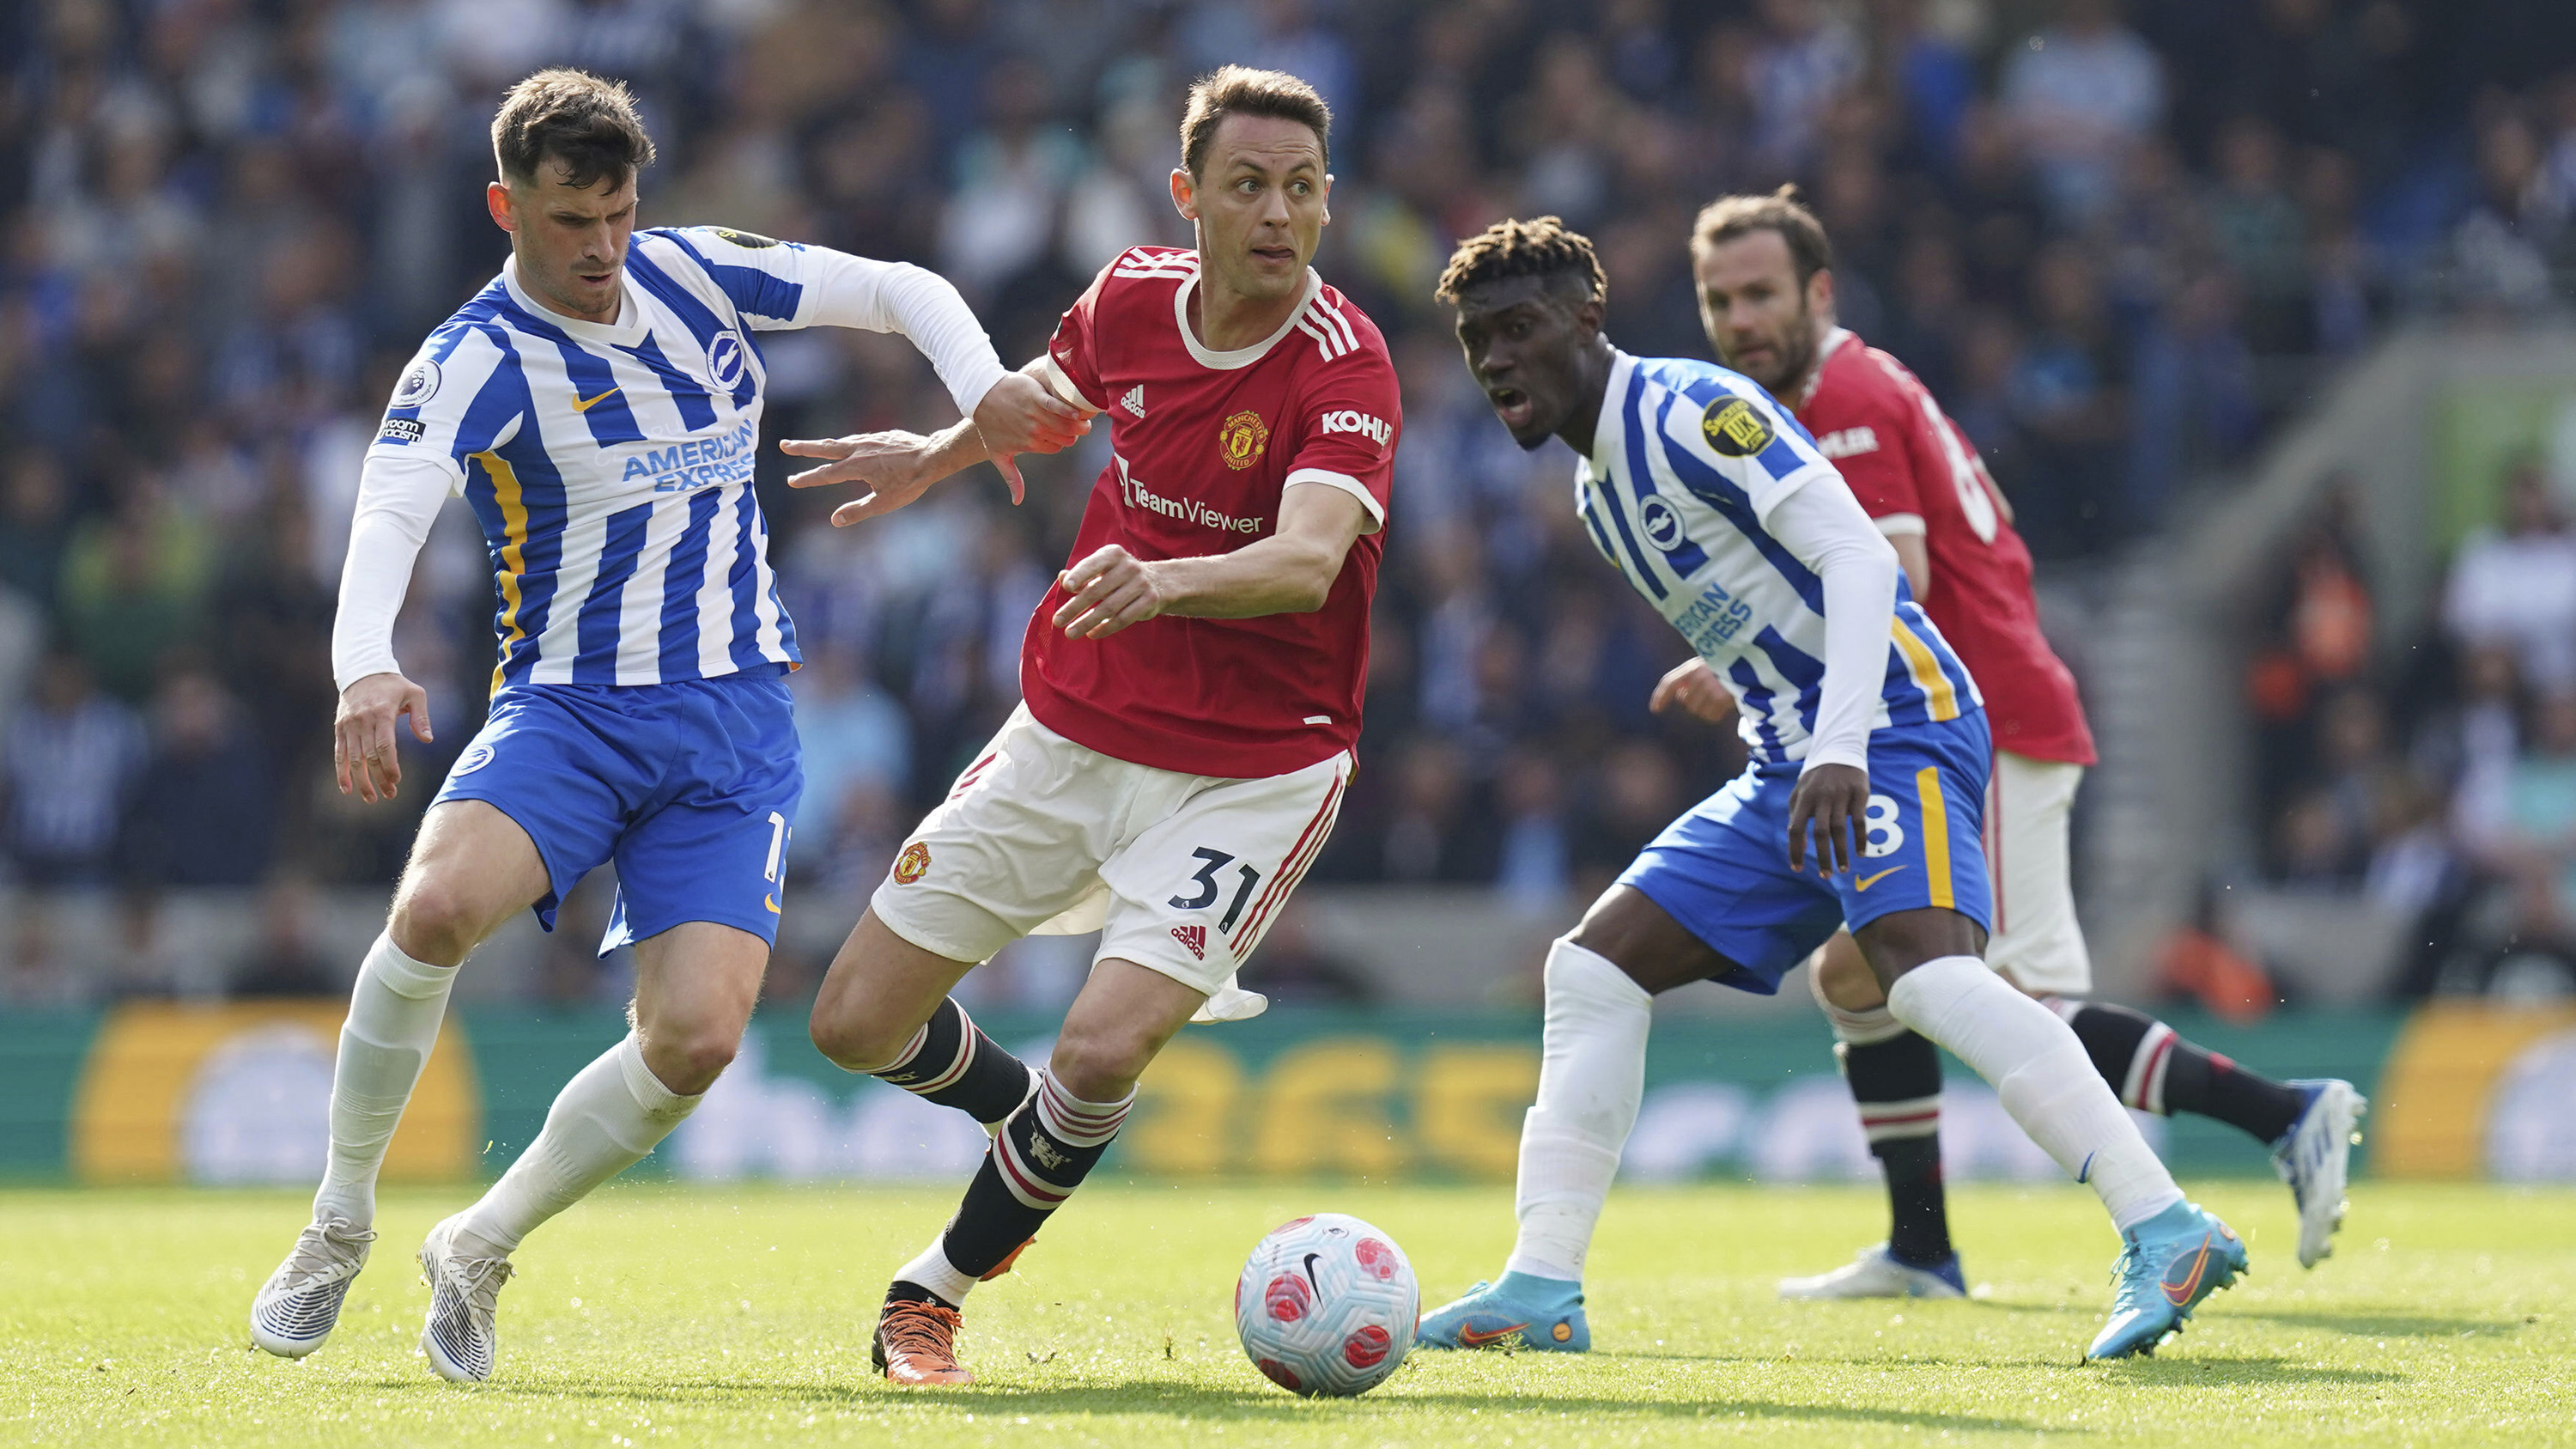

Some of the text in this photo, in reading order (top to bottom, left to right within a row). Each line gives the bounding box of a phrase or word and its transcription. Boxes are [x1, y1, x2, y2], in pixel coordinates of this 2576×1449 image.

[1121, 396, 1145, 419] adidas
[380, 428, 422, 442] racism
[386, 419, 419, 432] room
[1228, 415, 1263, 439] MANCHESTER
[1322, 410, 1392, 447] KOHLE
[1728, 415, 1757, 440] UK
[623, 419, 753, 482] AMERICAN
[1224, 452, 1249, 466] UNITED
[1130, 478, 1264, 533] TeamViewer
[1865, 795, 1905, 858] 8
[764, 811, 792, 894] 1
[1168, 846, 1261, 935] 31
[1171, 928, 1205, 961] adidas
